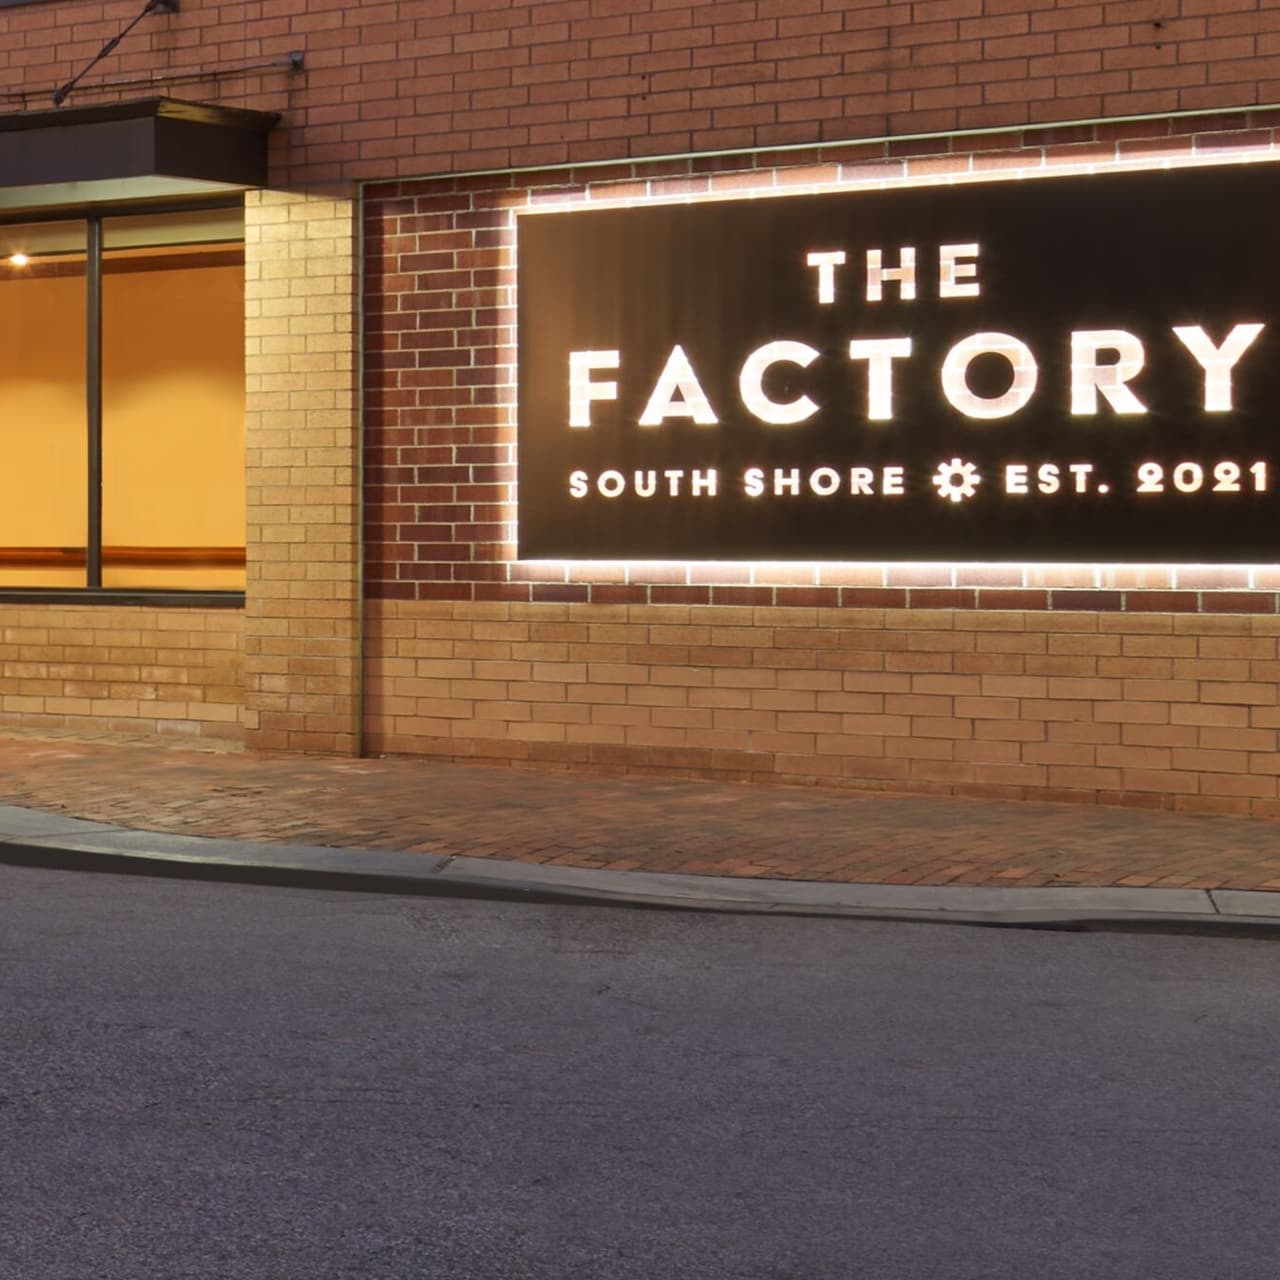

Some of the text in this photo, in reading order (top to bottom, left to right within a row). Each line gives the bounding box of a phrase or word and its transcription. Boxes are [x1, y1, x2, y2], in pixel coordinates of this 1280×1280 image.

[807, 243, 981, 304] THE
[568, 324, 1266, 428] FACTORY
[569, 461, 1267, 498] SOUTH SHORE EST. 2021
